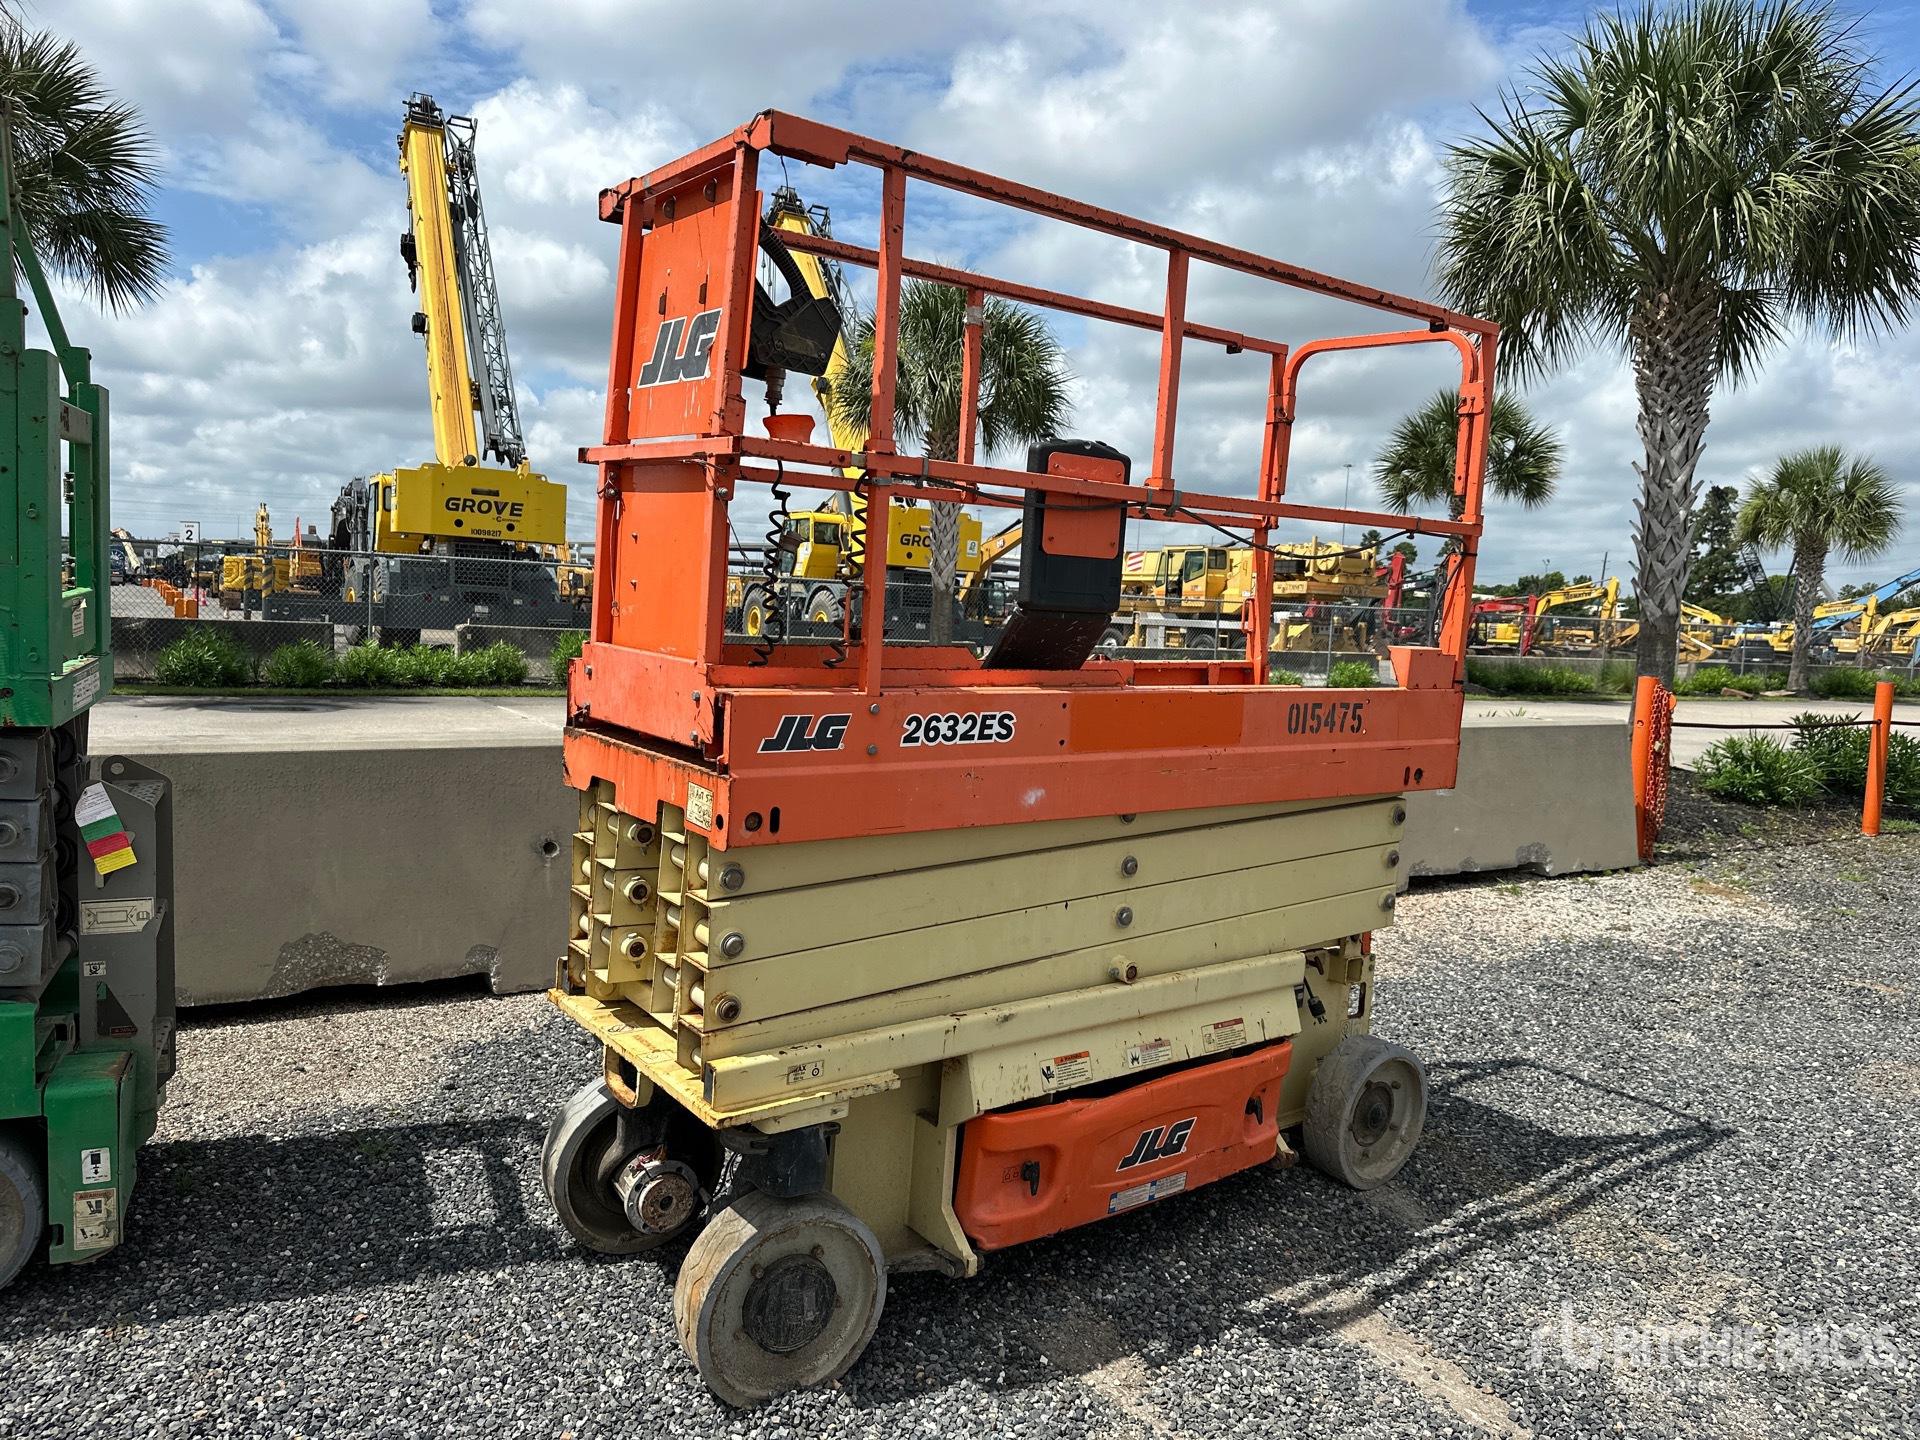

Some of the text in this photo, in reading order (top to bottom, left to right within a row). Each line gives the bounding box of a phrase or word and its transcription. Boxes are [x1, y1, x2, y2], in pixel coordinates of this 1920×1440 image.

[637, 307, 722, 389] JLG
[445, 497, 524, 517] GROVE
[185, 529, 193, 541] 2
[757, 713, 852, 753] JLG
[900, 711, 1017, 747] 2632ES
[1287, 702, 1364, 735] 015475
[1115, 1116, 1198, 1172] JLG
